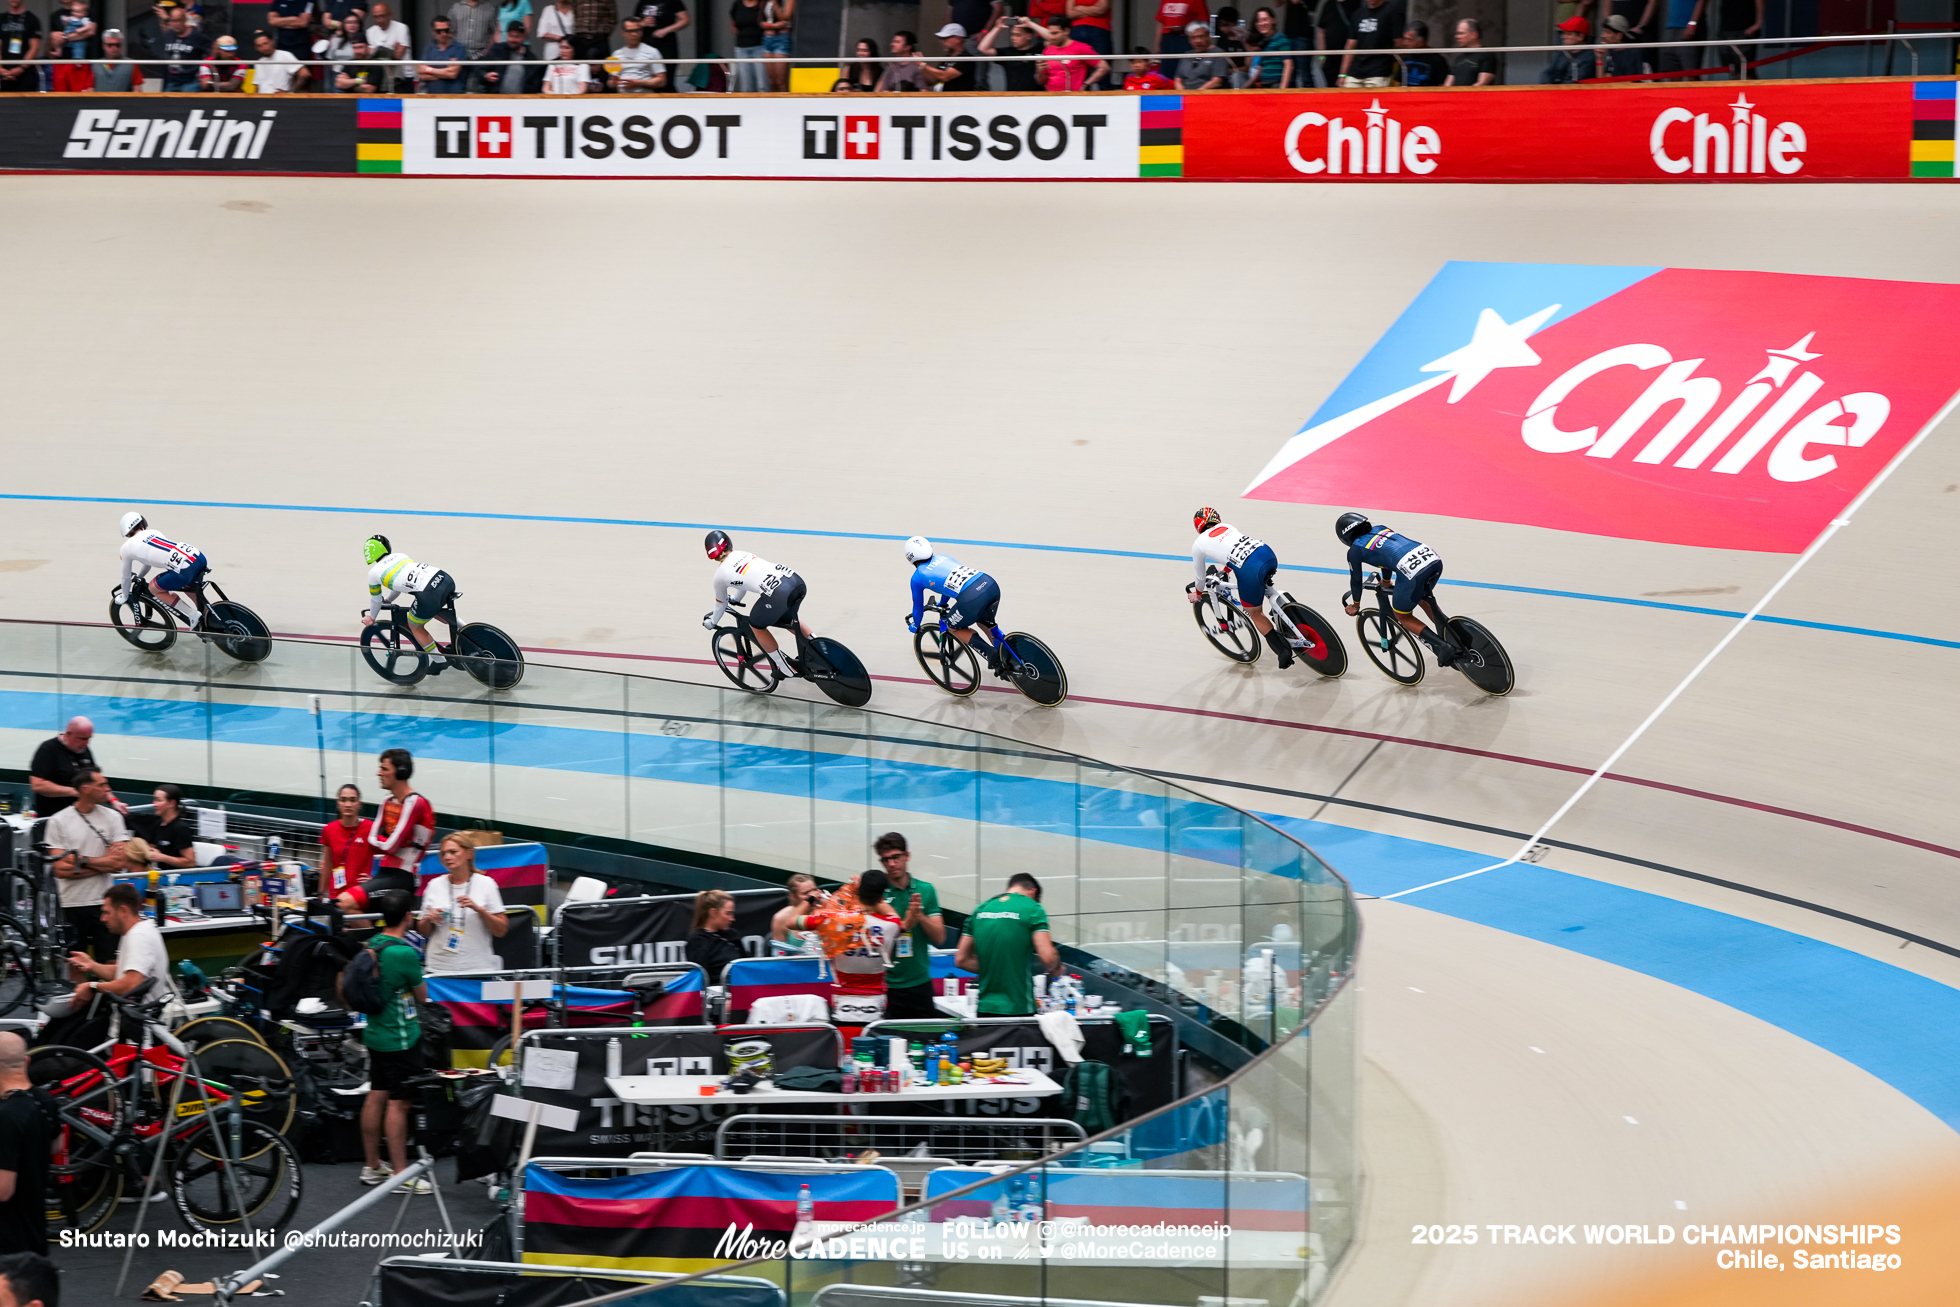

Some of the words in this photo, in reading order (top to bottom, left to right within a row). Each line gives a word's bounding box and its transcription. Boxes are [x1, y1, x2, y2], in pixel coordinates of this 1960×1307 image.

[62, 109, 278, 160] Santini
[523, 114, 741, 160] TISSOT
[890, 114, 1108, 161] TISSOT
[1284, 98, 1441, 175] Chile
[1649, 92, 1807, 175] Chile
[1520, 331, 1891, 483] Chile
[169, 551, 182, 565] 94
[589, 1097, 760, 1127] TISSO
[589, 1133, 632, 1145] SWISS
